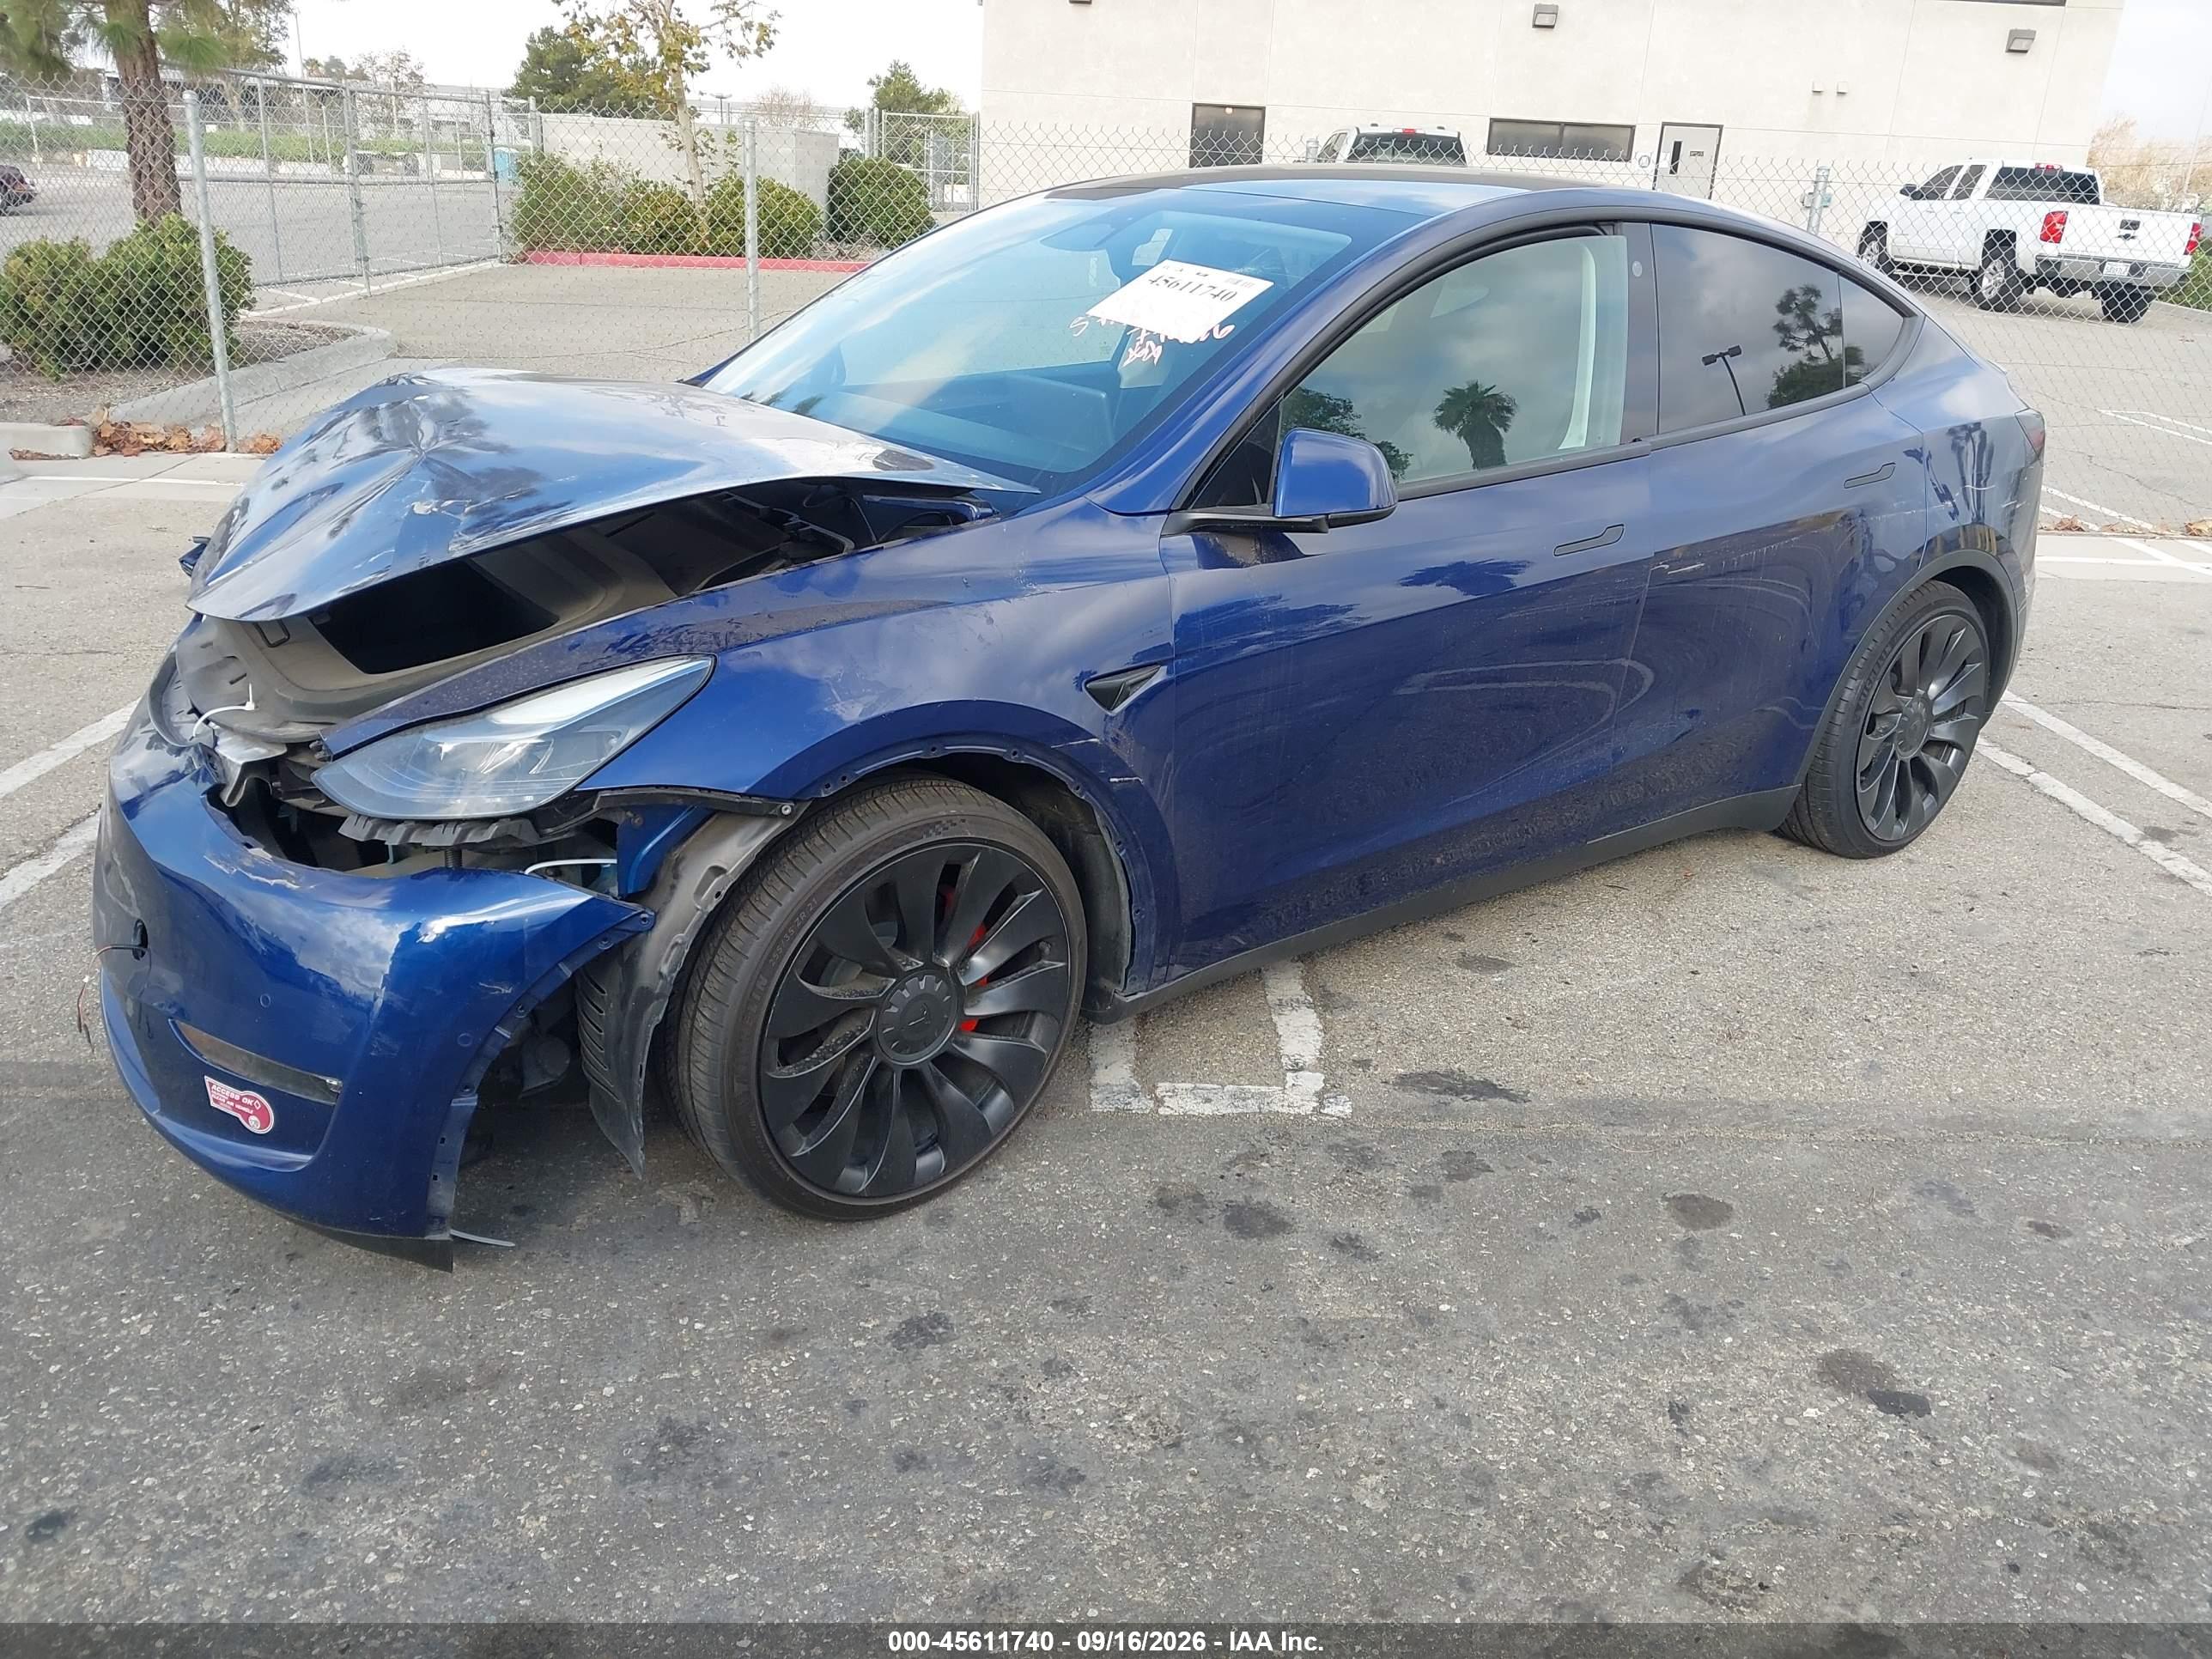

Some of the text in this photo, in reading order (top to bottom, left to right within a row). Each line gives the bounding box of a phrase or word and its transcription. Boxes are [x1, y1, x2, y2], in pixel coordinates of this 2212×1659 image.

[1149, 274, 1238, 301] 45611740
[211, 1085, 240, 1100] ACCESS
[241, 1097, 254, 1107] OK
